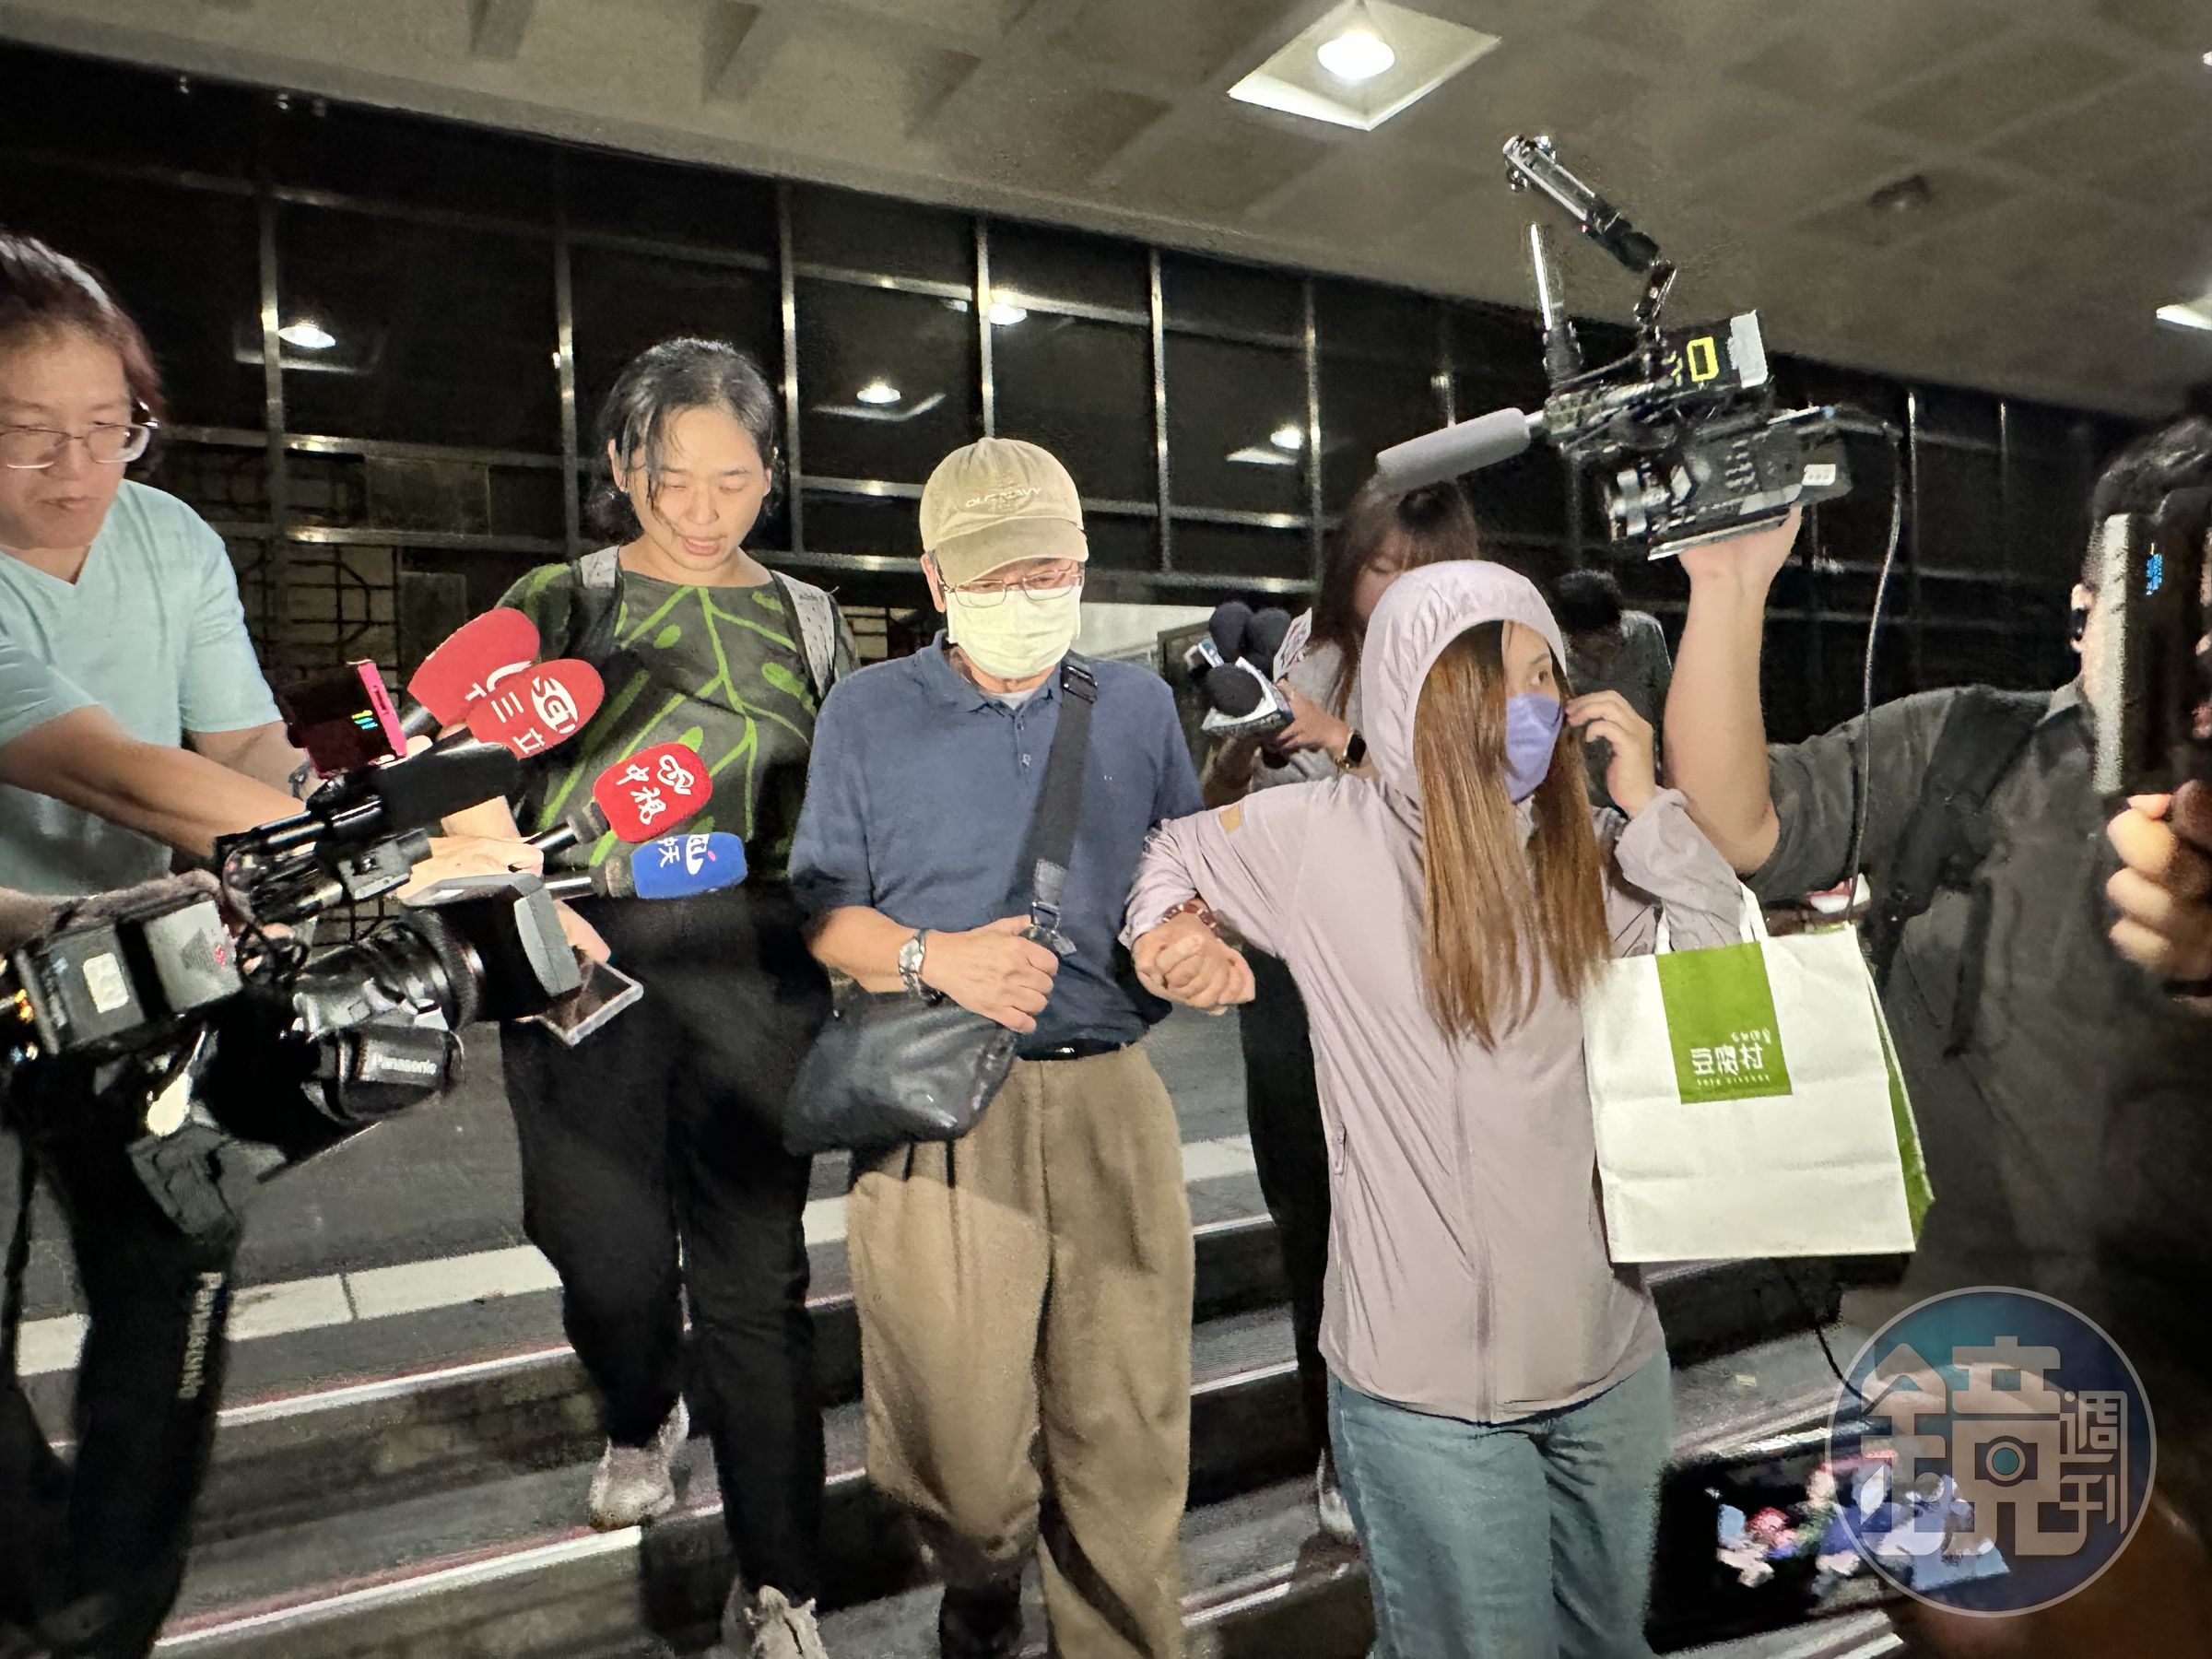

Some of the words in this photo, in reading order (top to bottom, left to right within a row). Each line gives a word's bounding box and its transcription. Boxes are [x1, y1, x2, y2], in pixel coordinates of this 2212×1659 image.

[491, 692, 546, 755] 三立
[616, 763, 666, 825] 中視
[658, 836, 680, 868] 中天
[372, 1053, 438, 1076] Panasonic
